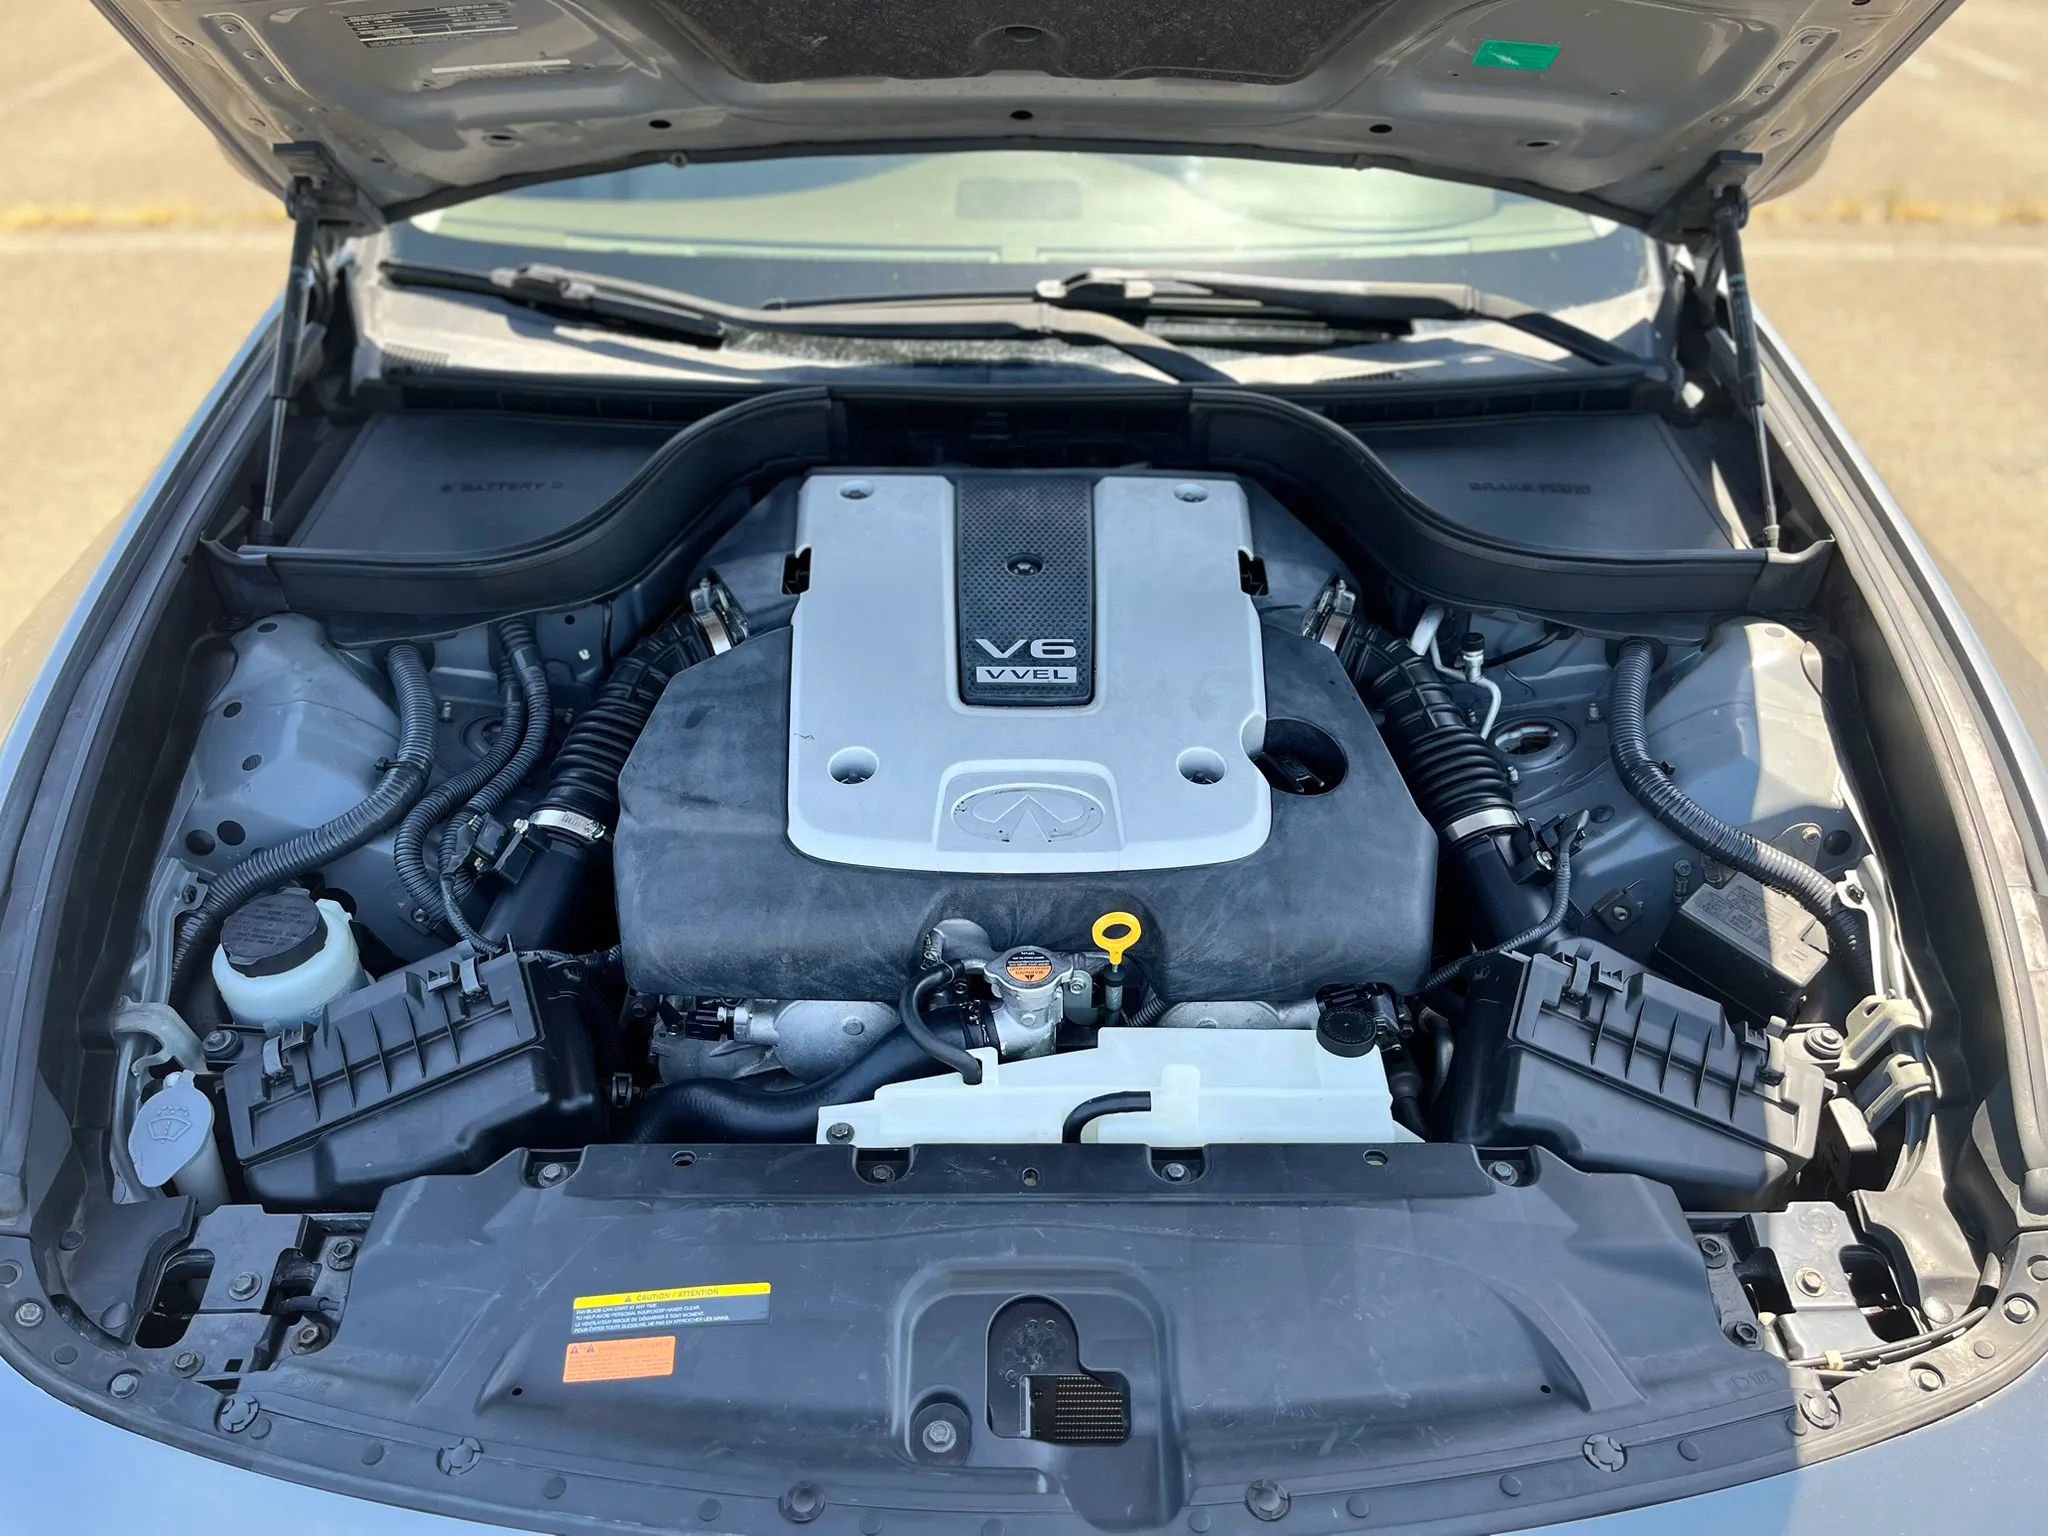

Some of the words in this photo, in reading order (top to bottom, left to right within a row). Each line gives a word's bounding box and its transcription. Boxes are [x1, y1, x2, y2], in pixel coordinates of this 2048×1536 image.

[975, 639, 1077, 658] V6
[985, 669, 1069, 680] VVEL
[636, 1292, 669, 1302] CAUTION
[678, 1288, 719, 1298] ATTENTION
